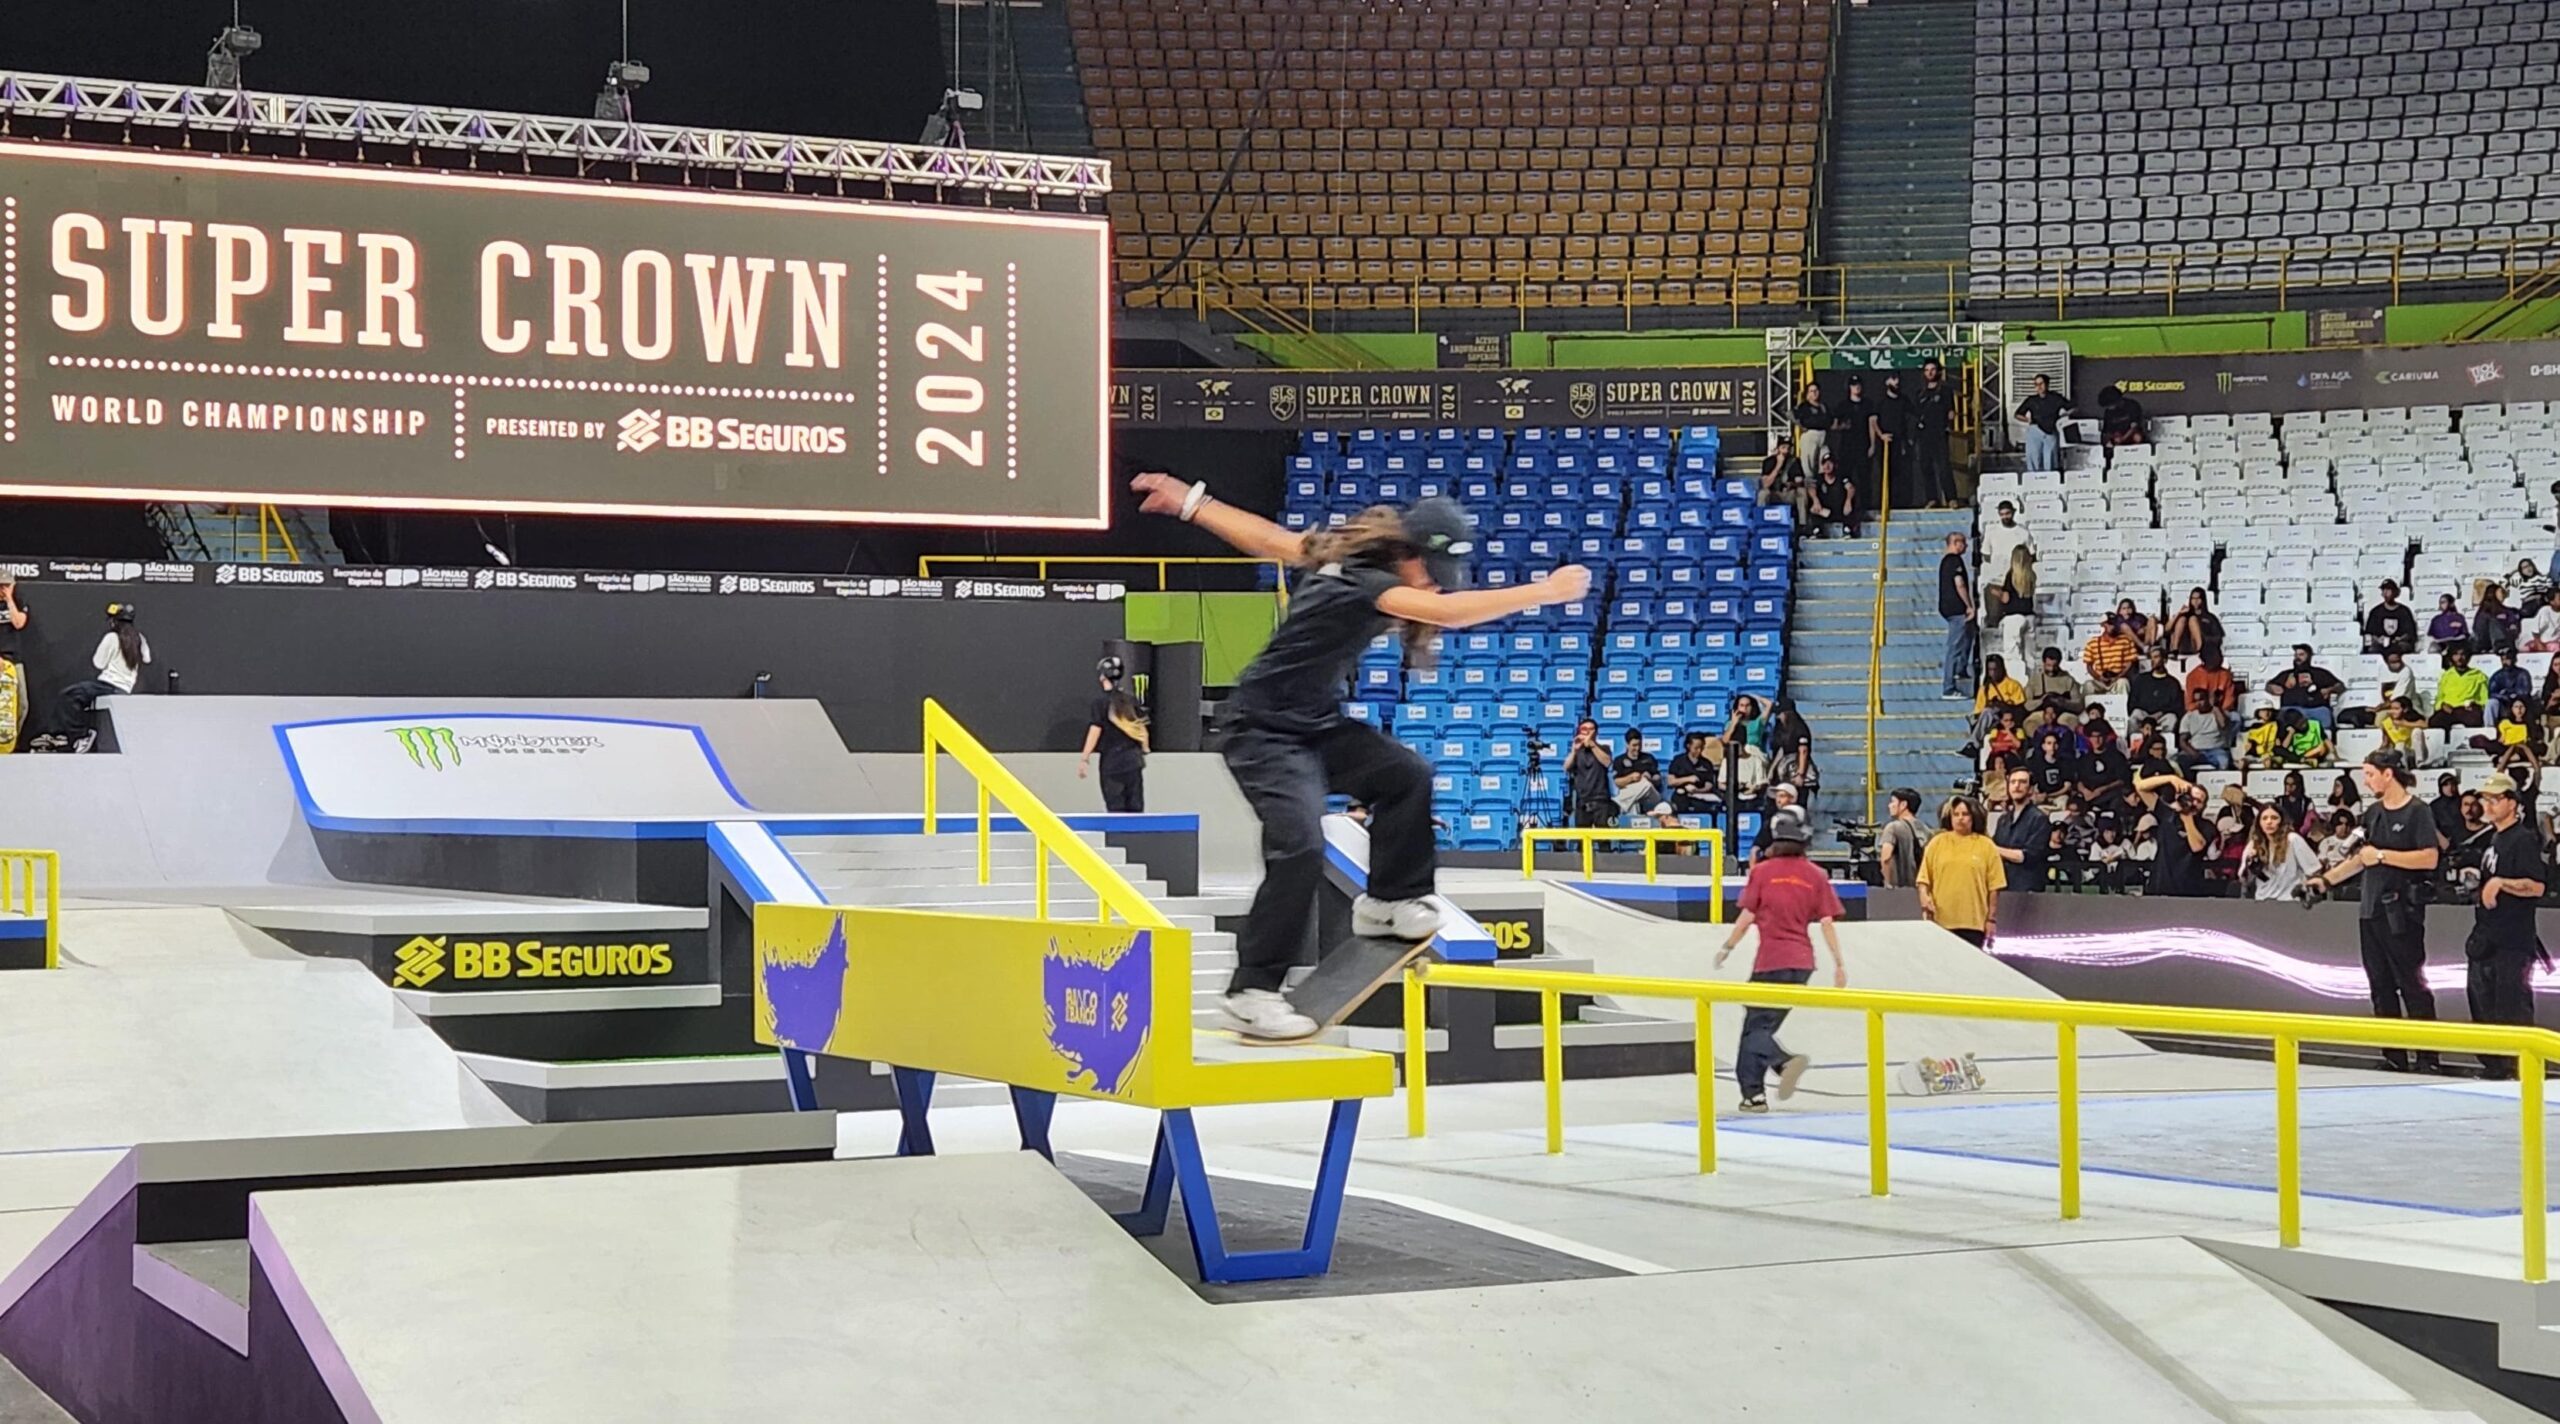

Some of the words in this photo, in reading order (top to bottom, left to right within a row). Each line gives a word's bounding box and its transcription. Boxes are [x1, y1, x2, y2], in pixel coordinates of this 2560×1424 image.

[50, 212, 424, 348] SUPER
[480, 240, 847, 369] CROWN
[915, 270, 984, 467] 2024
[2390, 371, 2439, 382] CARIUMA
[1141, 386, 1155, 420] 2024
[1271, 388, 1295, 402] SLS
[1306, 385, 1362, 405] SUPER
[1370, 385, 1431, 405] CROWN
[1442, 385, 1456, 419] 2024
[1571, 385, 1595, 399] SLS
[1606, 382, 1662, 403] SUPER
[1670, 381, 1732, 401] CROWN
[1742, 381, 1756, 415] 2024
[51, 394, 164, 426] WORLD
[182, 401, 426, 436] CHAMPIONSHIP
[486, 417, 578, 439] PRESENTED
[584, 421, 606, 440] BY
[667, 416, 713, 449] BB
[717, 418, 847, 454] SEGUROS
[238, 567, 261, 583] BB
[263, 568, 324, 584] SEGUROS
[496, 572, 517, 587] BB
[519, 572, 577, 588] SEGUROS
[740, 578, 759, 592] BB
[761, 578, 815, 593] SEGUROS
[973, 582, 993, 596] BB
[994, 583, 1045, 598] SEGUROS
[459, 735, 604, 749] MONSTER
[454, 941, 510, 978] BB
[517, 941, 673, 977] SEGUROS
